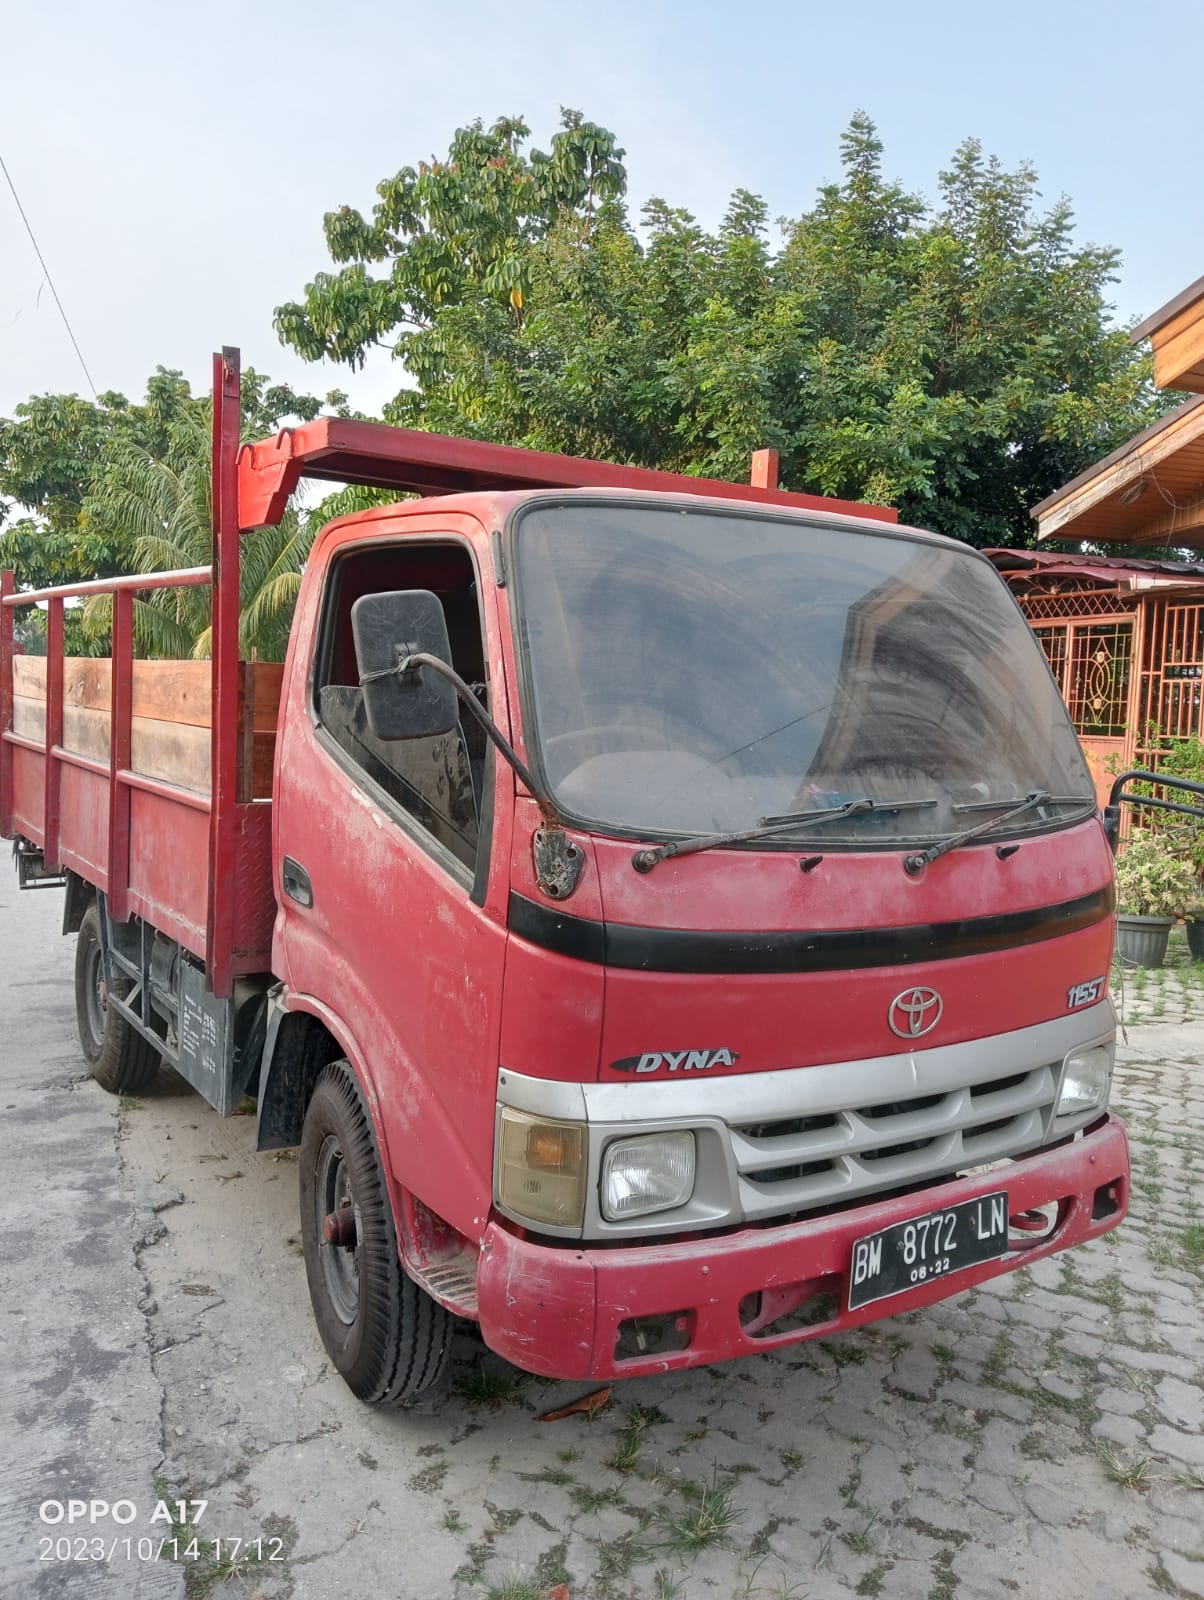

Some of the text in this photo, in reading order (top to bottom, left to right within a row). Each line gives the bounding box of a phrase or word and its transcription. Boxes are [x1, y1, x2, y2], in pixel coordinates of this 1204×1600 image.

[635, 1047, 735, 1073] DYNA
[854, 1197, 1004, 1285] BM 8772 LN
